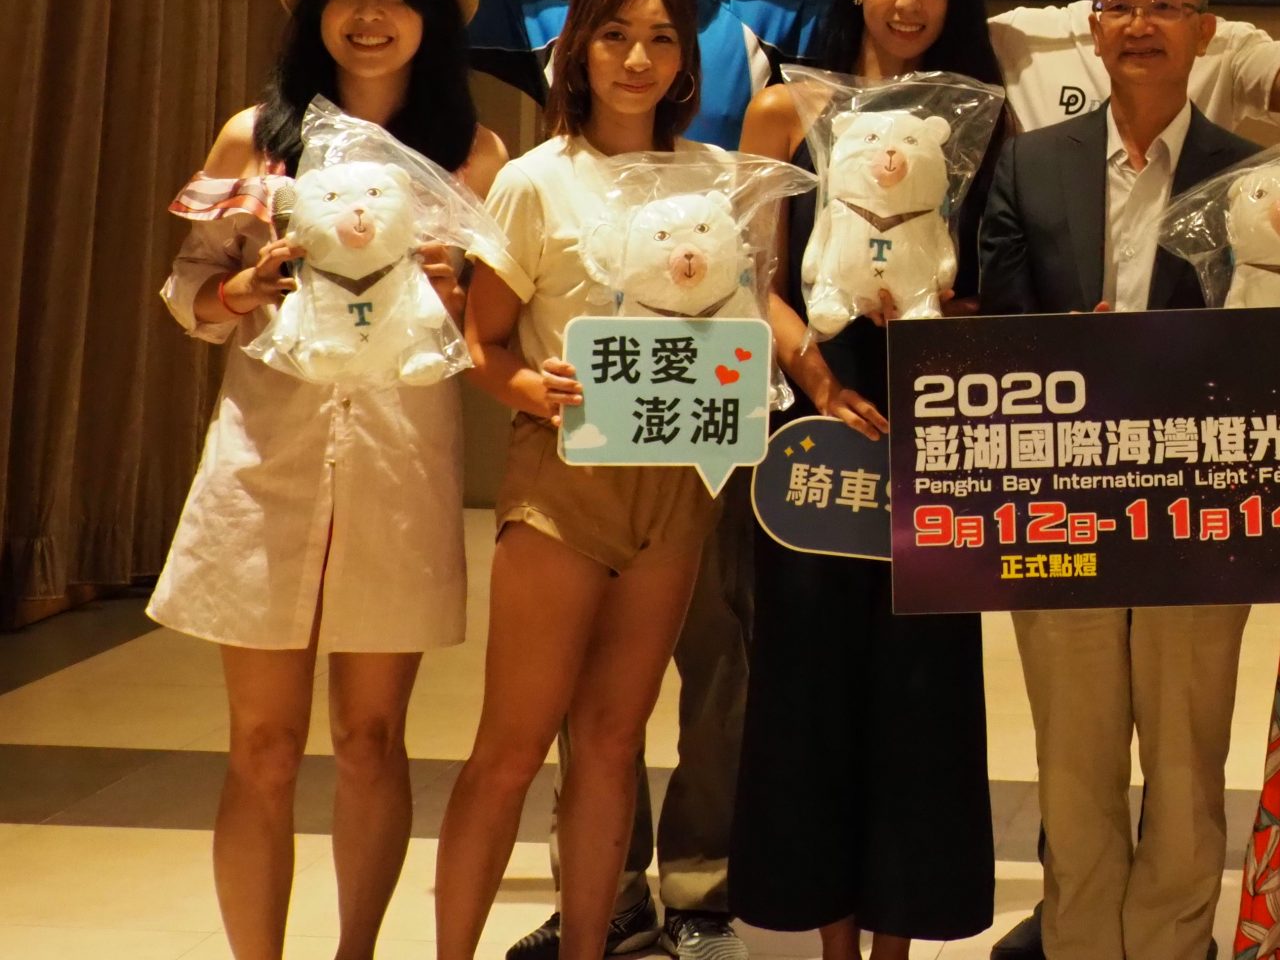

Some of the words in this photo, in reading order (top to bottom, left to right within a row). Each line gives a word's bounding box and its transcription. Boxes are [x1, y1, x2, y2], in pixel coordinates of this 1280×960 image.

[591, 335, 698, 386] 我愛
[914, 370, 1087, 418] 2020
[631, 396, 740, 446] 澎湖
[786, 462, 892, 513] 騎車
[915, 475, 992, 497] Penghu
[1003, 475, 1042, 495] Bay
[1053, 470, 1184, 490] International
[1195, 468, 1248, 489] Light
[1000, 552, 1099, 581] 正式點燈
